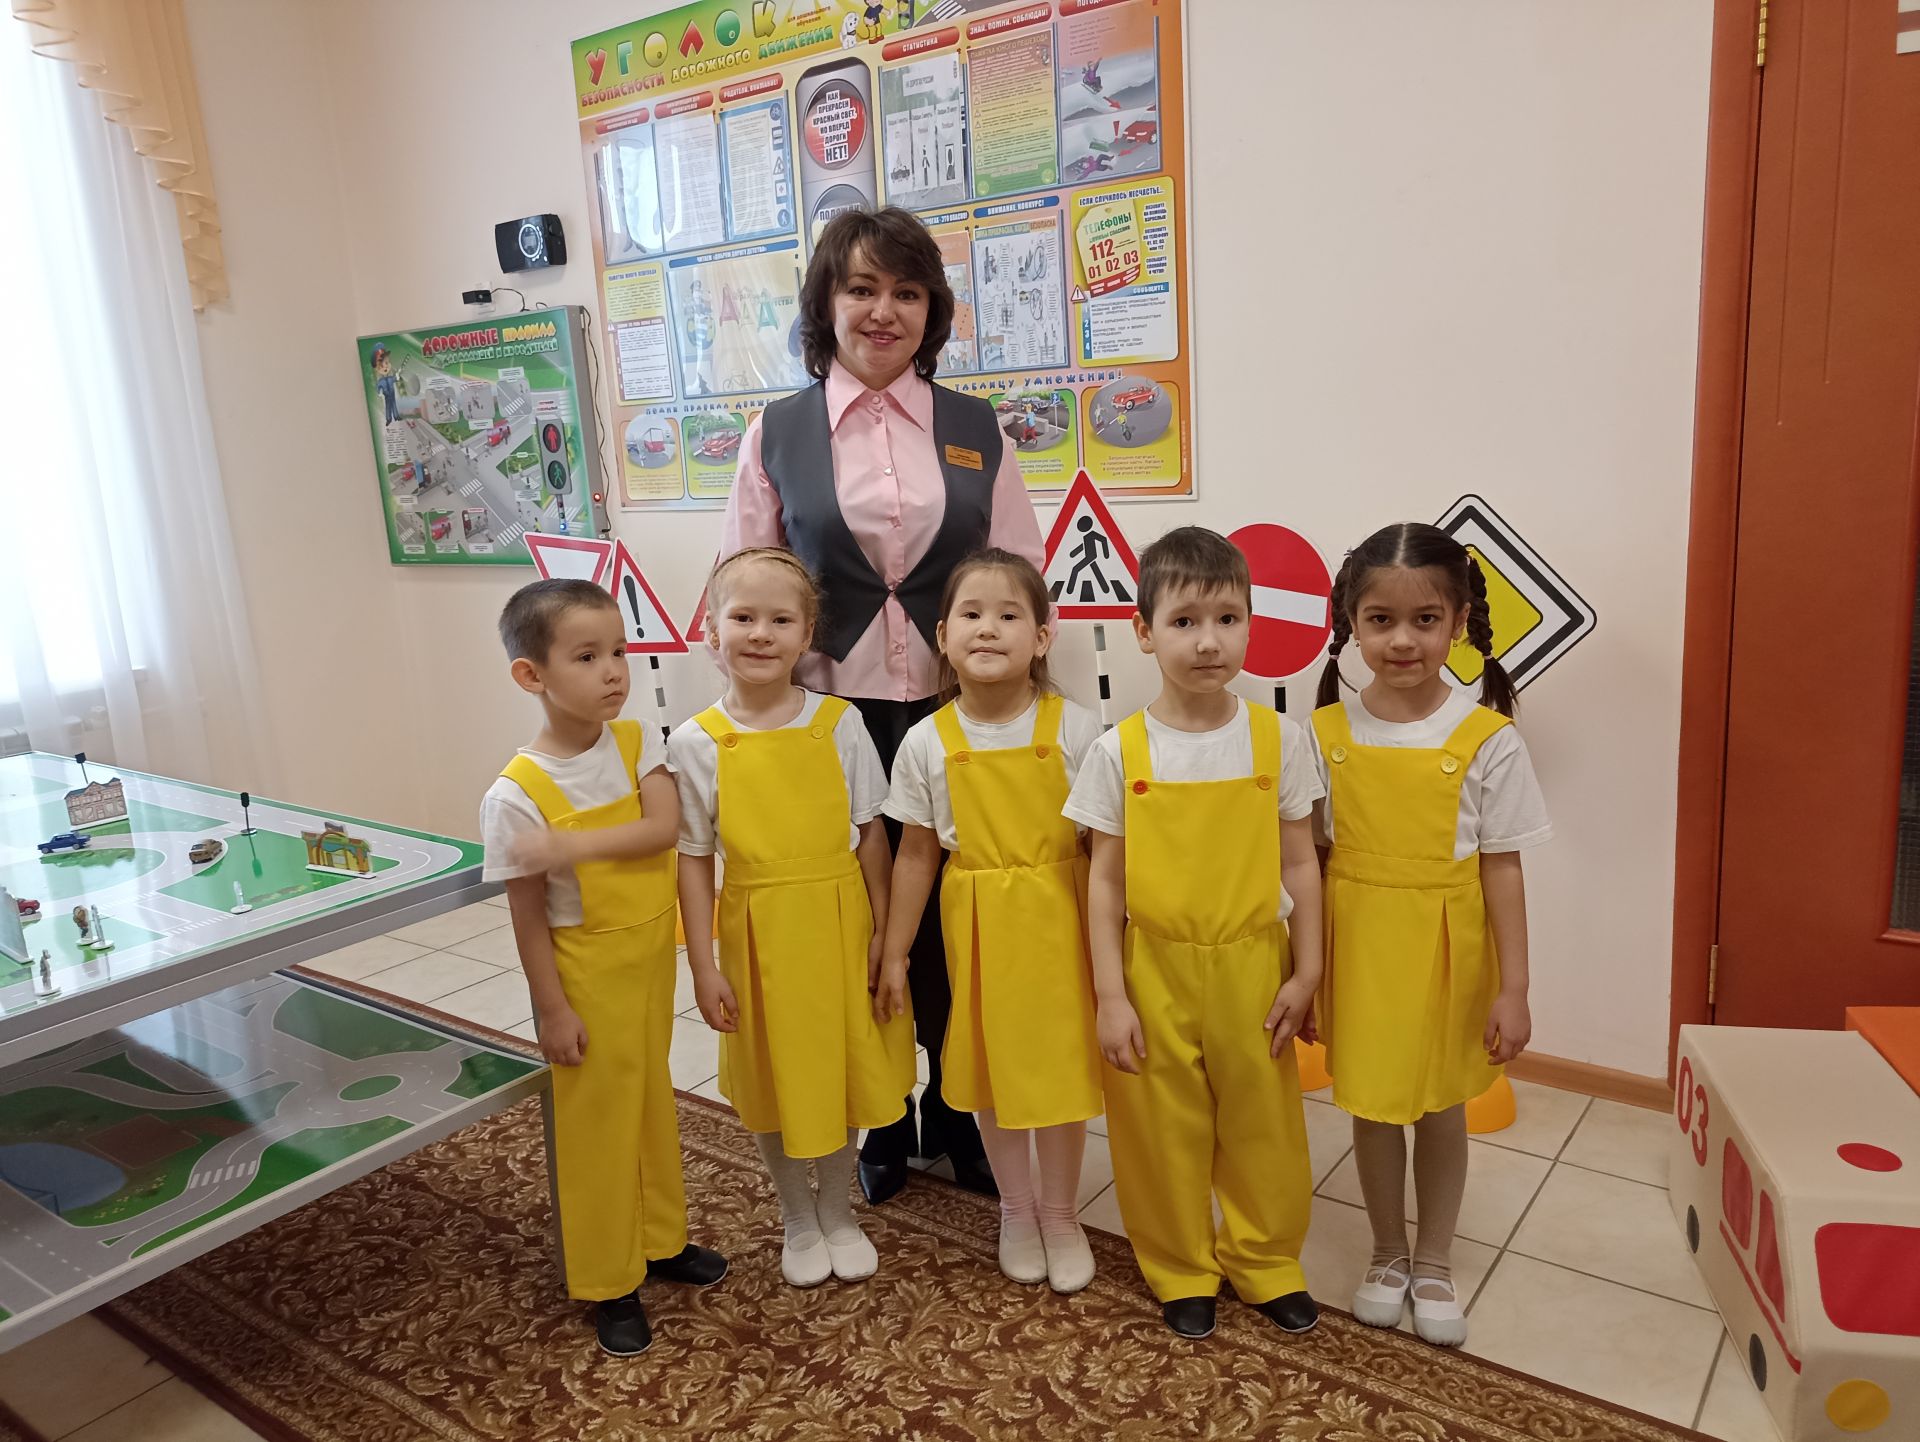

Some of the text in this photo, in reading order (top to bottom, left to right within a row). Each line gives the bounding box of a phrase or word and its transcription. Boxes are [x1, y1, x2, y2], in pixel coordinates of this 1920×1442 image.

[584, 0, 777, 86] УГОЛОК
[902, 37, 938, 52] СТАТИСТИКА
[581, 25, 833, 107] БЕЗОПАСНОСТИ ДОРОЖНОГО ДВИЖЕНИЯ
[827, 92, 839, 101] КАК
[818, 101, 849, 114] ПРЕКРАСЕН
[813, 112, 840, 126] КРАСНЫЙ
[820, 121, 850, 134] НО ВПЕРЕД
[825, 133, 847, 144] ДОРОГИ
[825, 146, 848, 161] НЕТ!
[1079, 197, 1093, 206] ЕСЛИ
[1094, 193, 1127, 204] СЛУЧИЛОСЬ
[1083, 212, 1132, 235] ТЕЛЕФОНЫ
[1089, 238, 1115, 261] 112
[1088, 250, 1139, 279] 01 02 03
[422, 321, 556, 357] ДОРОЖНЫЕ ПРАВИЛА
[955, 379, 1014, 392] ТАБЛИЦУ
[1677, 1056, 1709, 1167] 03
